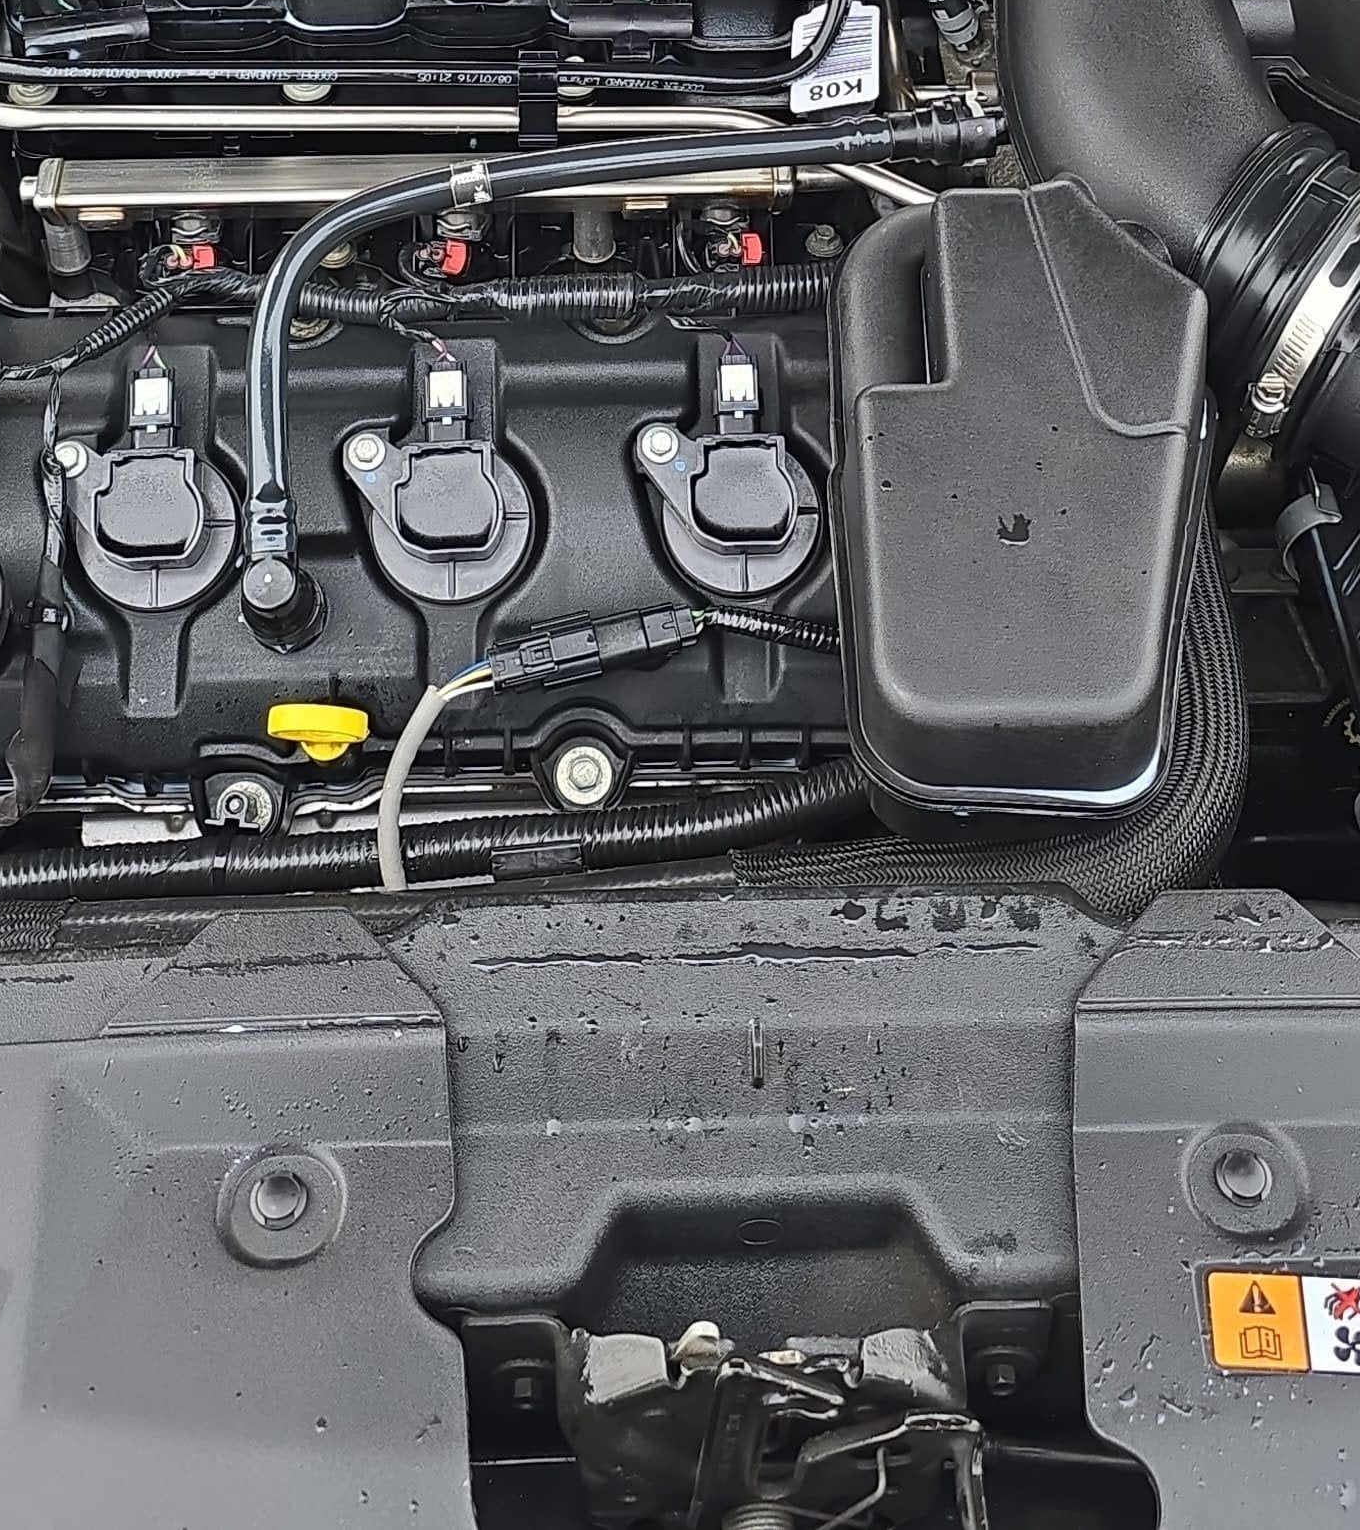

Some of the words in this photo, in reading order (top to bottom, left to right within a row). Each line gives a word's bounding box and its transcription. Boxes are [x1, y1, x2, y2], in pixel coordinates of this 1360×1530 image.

[417, 71, 452, 83] 21:05
[456, 73, 513, 85] 08/01/16
[808, 77, 863, 102] K08
